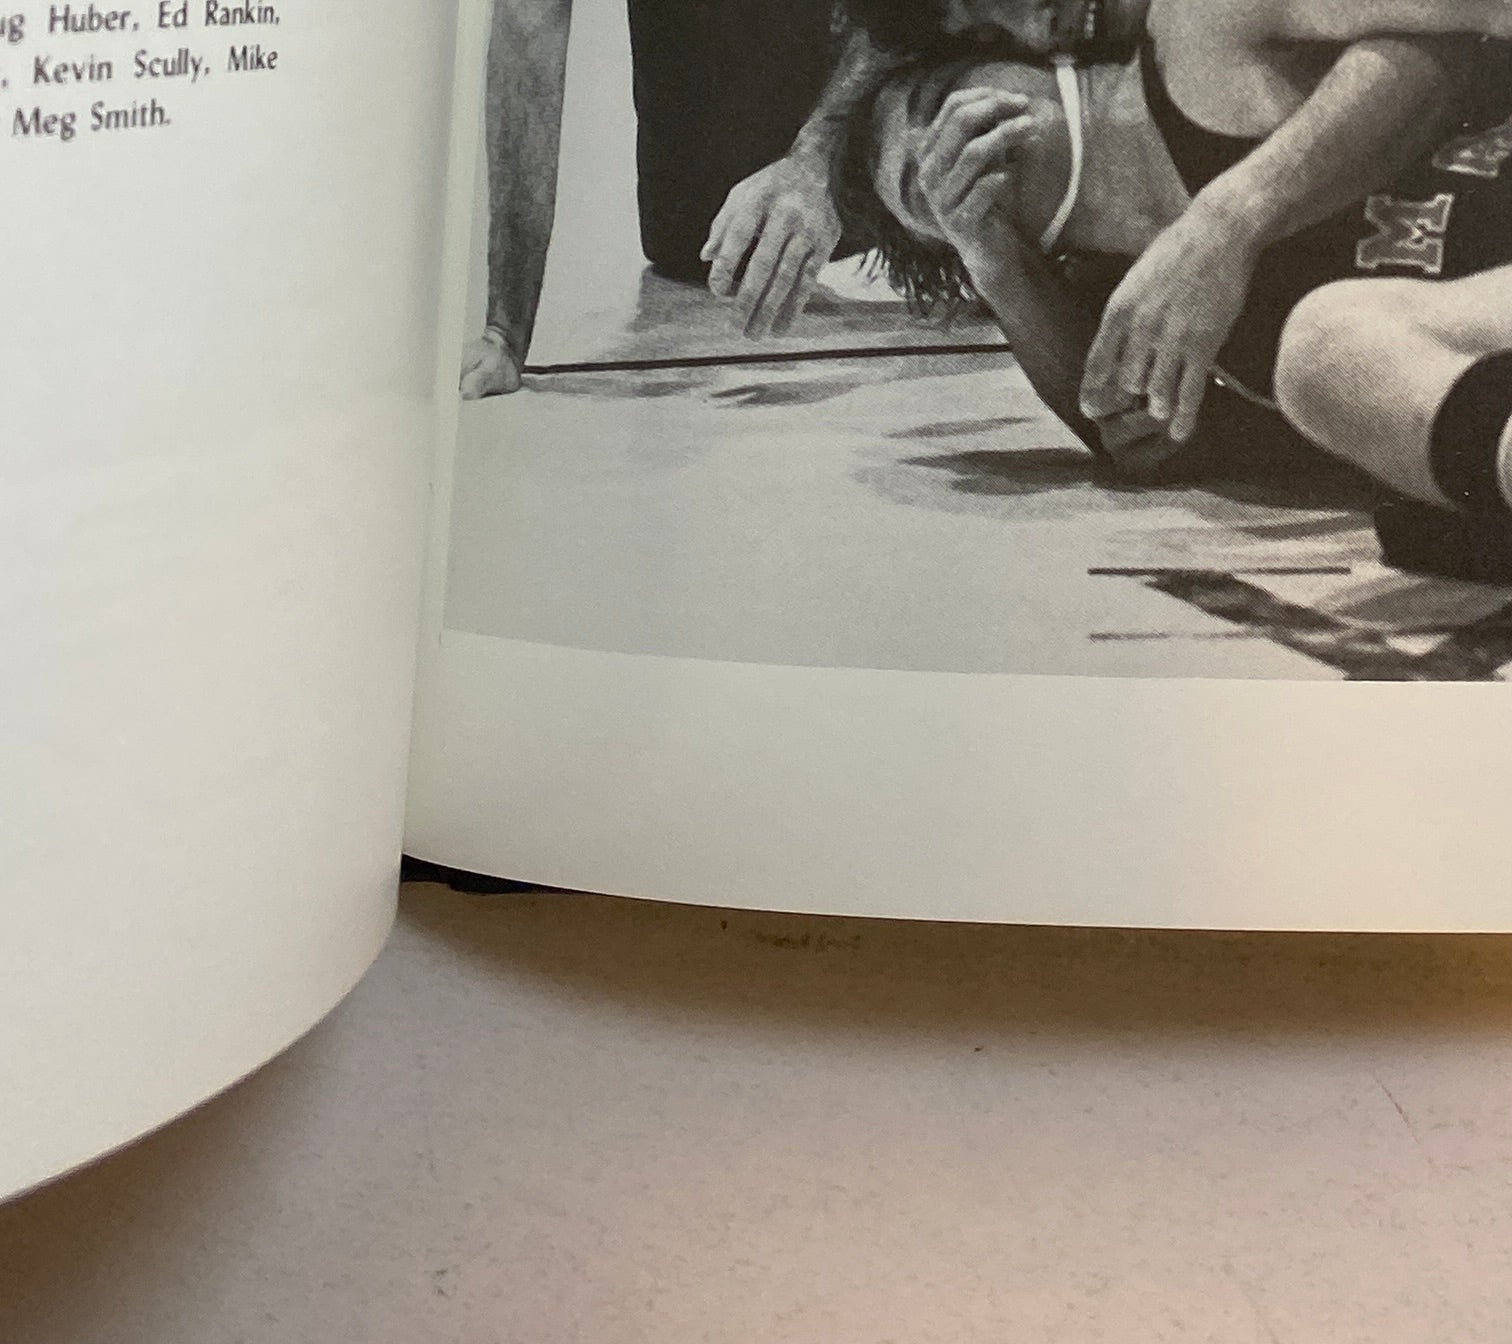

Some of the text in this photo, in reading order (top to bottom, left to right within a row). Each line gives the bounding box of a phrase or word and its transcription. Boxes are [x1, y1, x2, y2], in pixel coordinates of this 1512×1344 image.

[48, 3, 139, 34] Huber,
[158, 0, 188, 29] Ed
[33, 44, 278, 85] Kevin Scully, Mike
[13, 98, 171, 142] Meg Smith.
